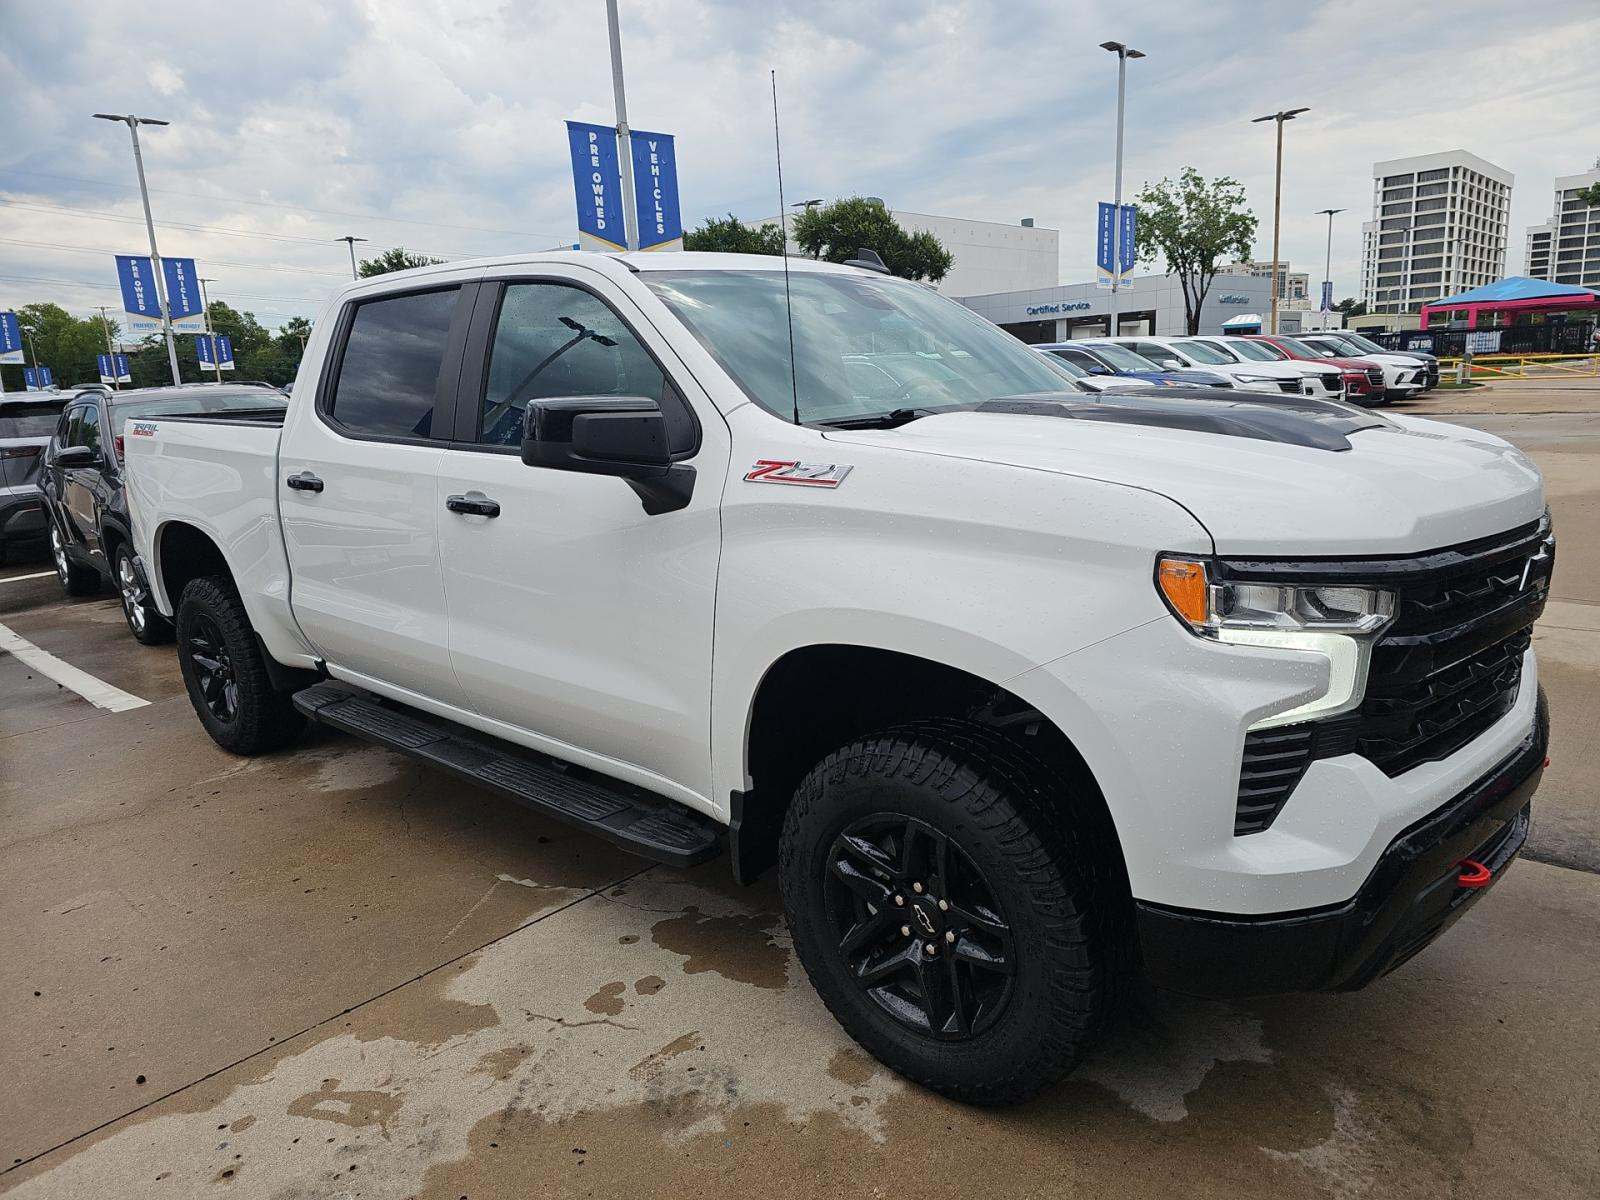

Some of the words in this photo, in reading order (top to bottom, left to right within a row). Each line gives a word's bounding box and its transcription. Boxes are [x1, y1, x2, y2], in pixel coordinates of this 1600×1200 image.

[588, 131, 600, 168] PRE
[591, 171, 606, 230] OWNED
[648, 140, 665, 235] VEHICLES
[130, 259, 140, 279] PRE
[133, 280, 146, 311] OWNED
[175, 262, 190, 313] VEHICLES
[1026, 304, 1060, 316] Certified
[1061, 301, 1091, 313] Service
[742, 458, 855, 489] Z71
